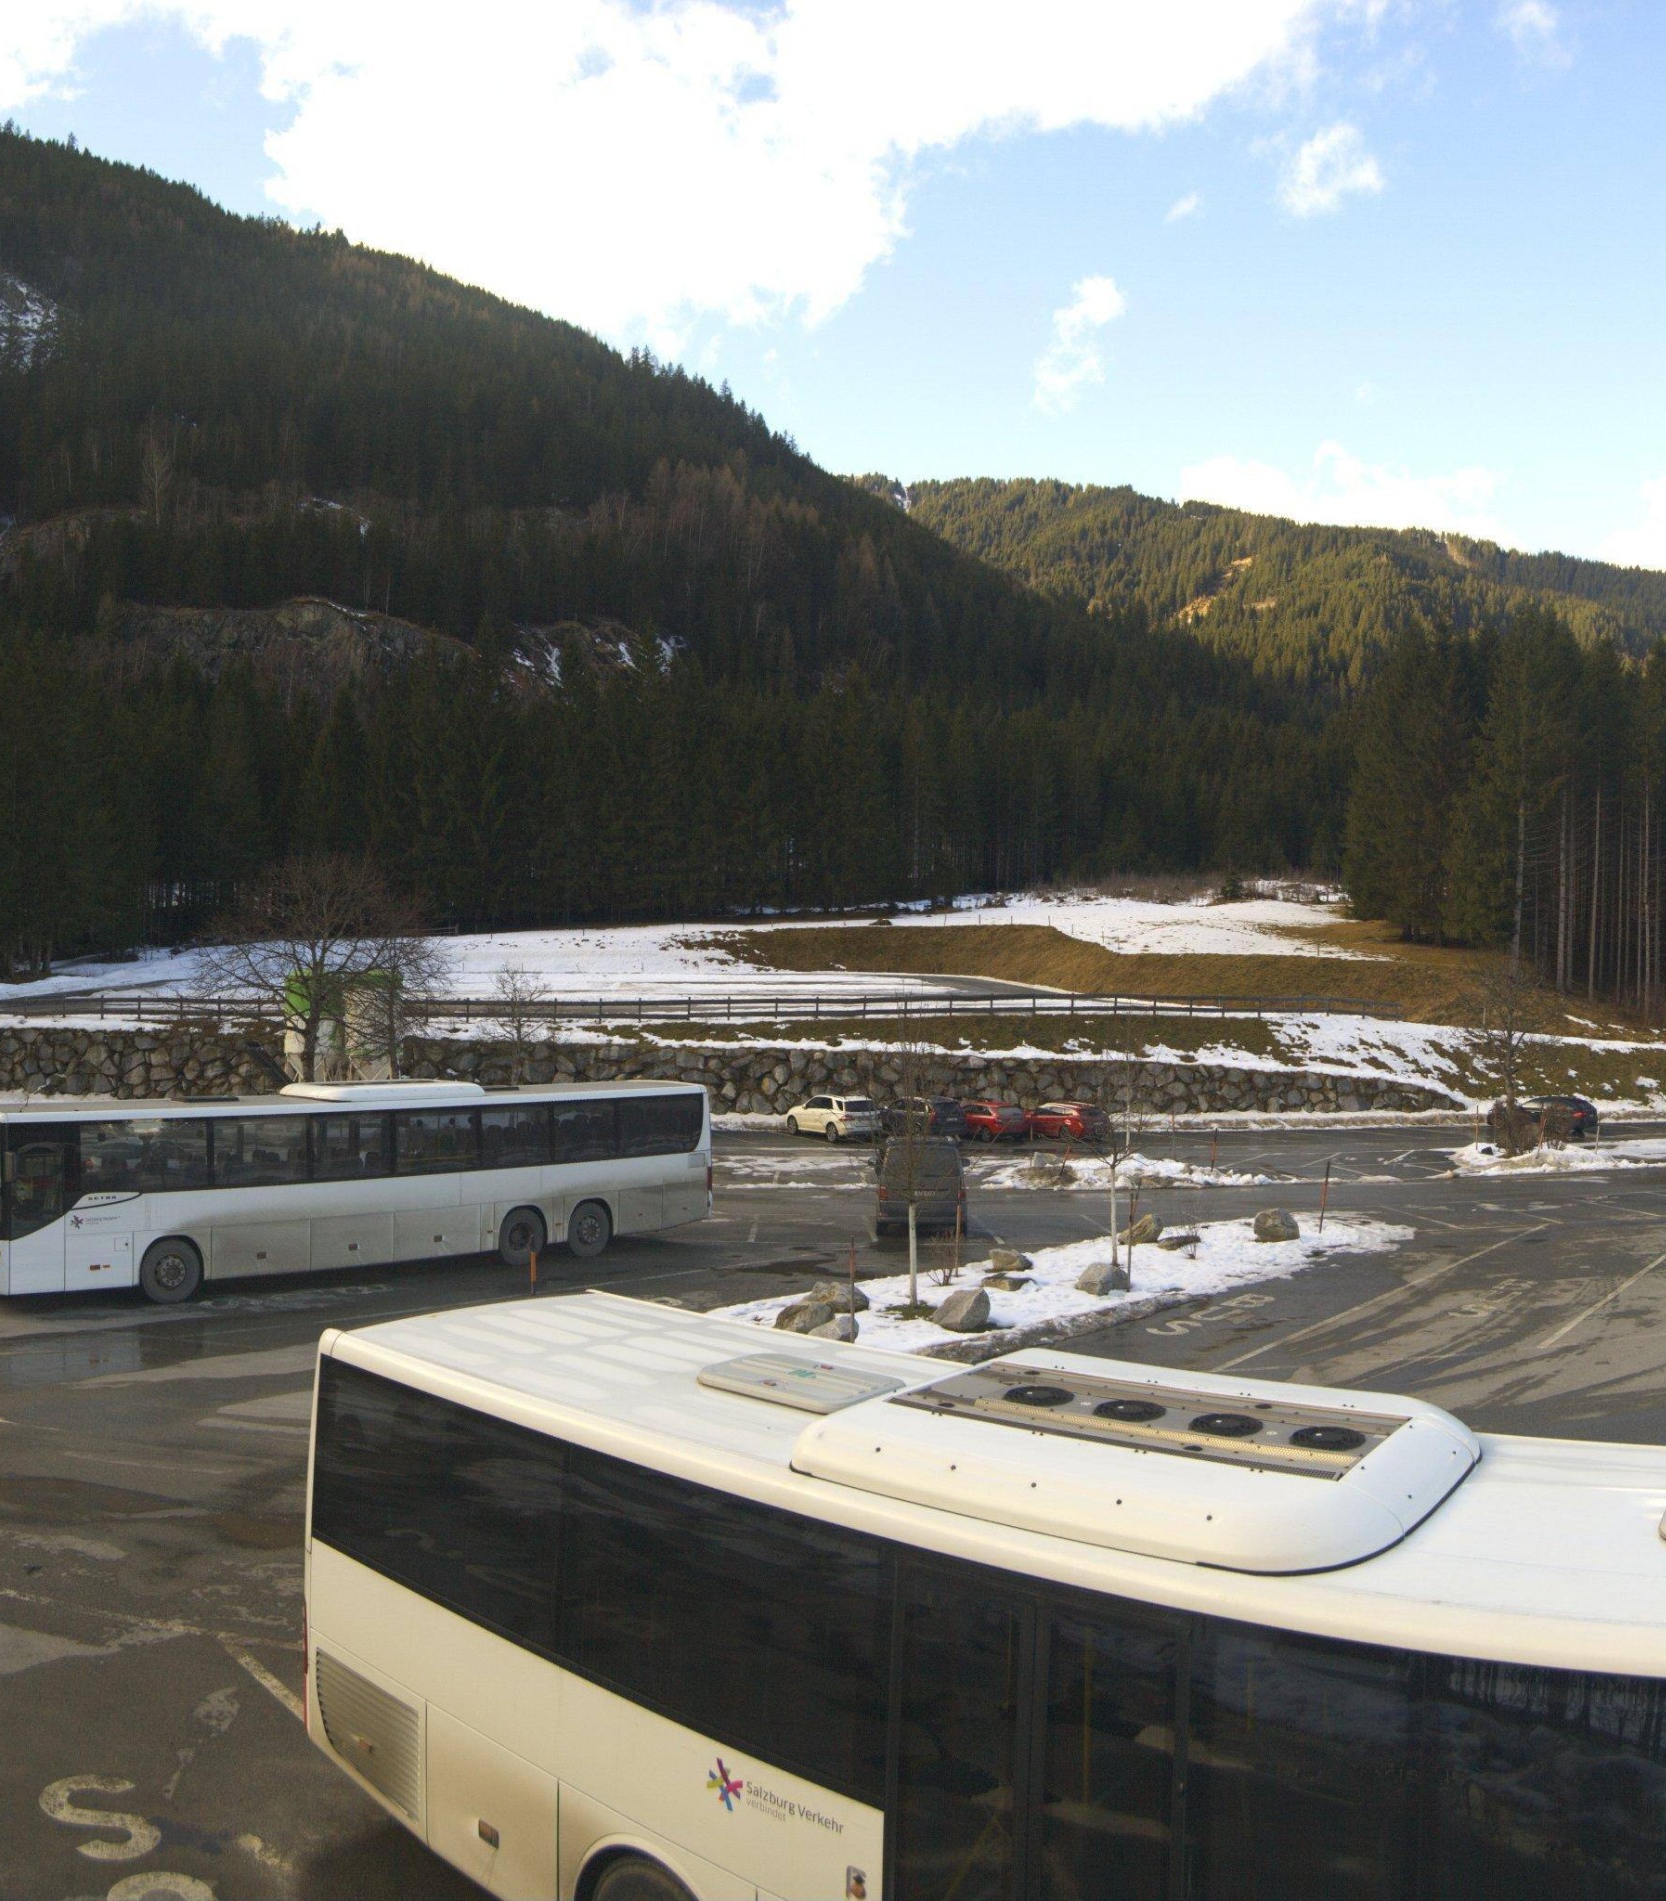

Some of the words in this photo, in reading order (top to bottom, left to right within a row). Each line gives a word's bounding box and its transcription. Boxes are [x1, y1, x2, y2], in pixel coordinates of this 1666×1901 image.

[1145, 1293, 1276, 1336] BUS
[746, 1781, 796, 1816] Salzburg
[797, 1803, 844, 1834] Verkehr
[746, 1798, 786, 1822] verbindet
